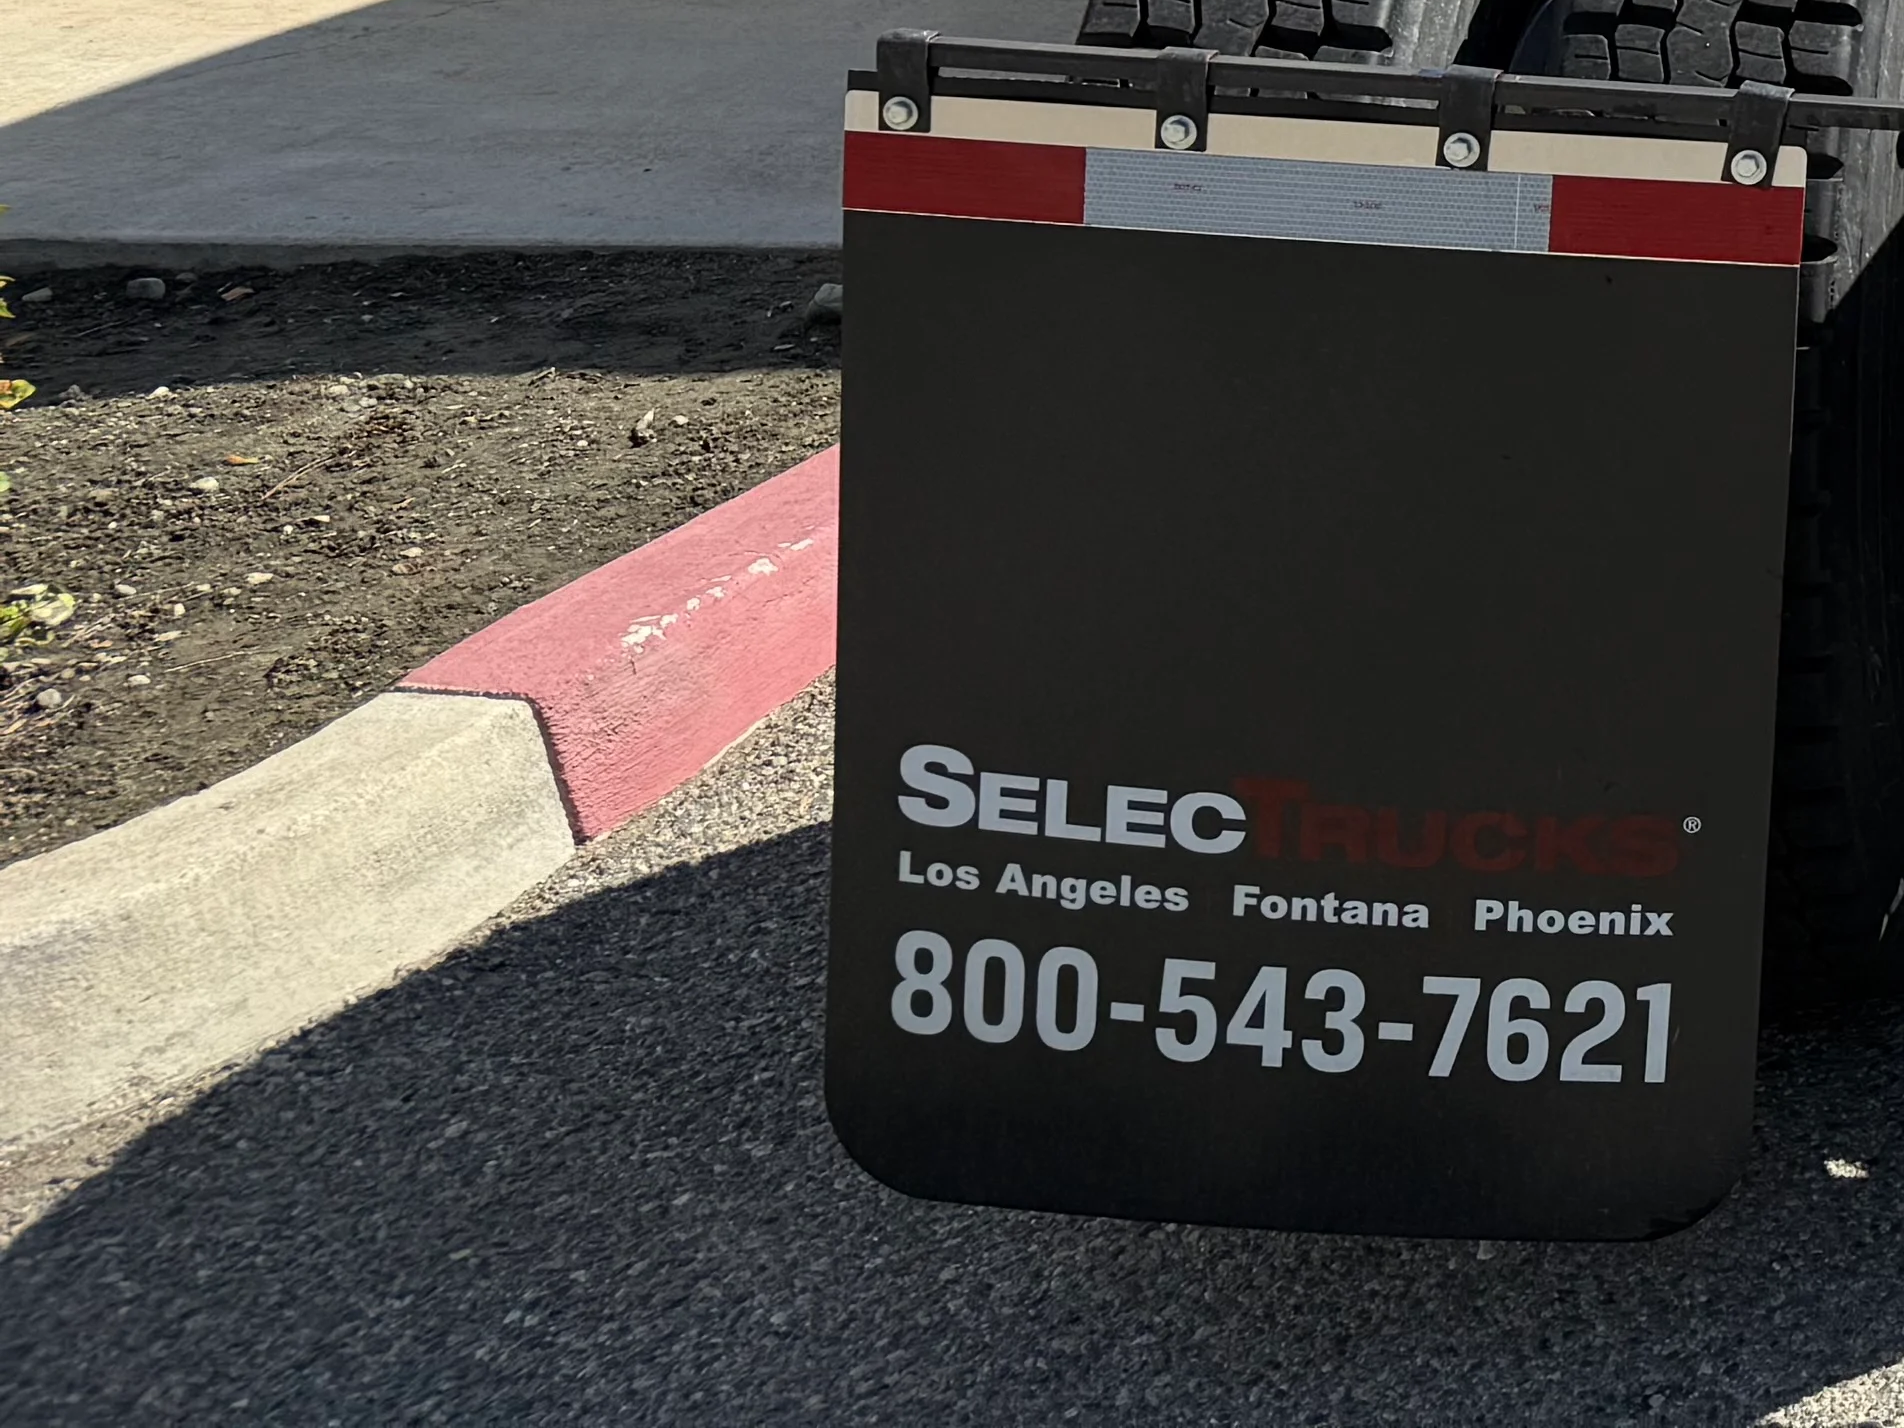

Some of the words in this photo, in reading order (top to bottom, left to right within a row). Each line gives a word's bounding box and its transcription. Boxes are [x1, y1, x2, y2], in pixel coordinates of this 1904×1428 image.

[898, 850, 980, 891] Los
[996, 863, 1190, 912] Angeles
[1233, 885, 1429, 929] Fontana
[1475, 899, 1673, 938] Phoenix
[891, 930, 1672, 1084] 800-543-7621
